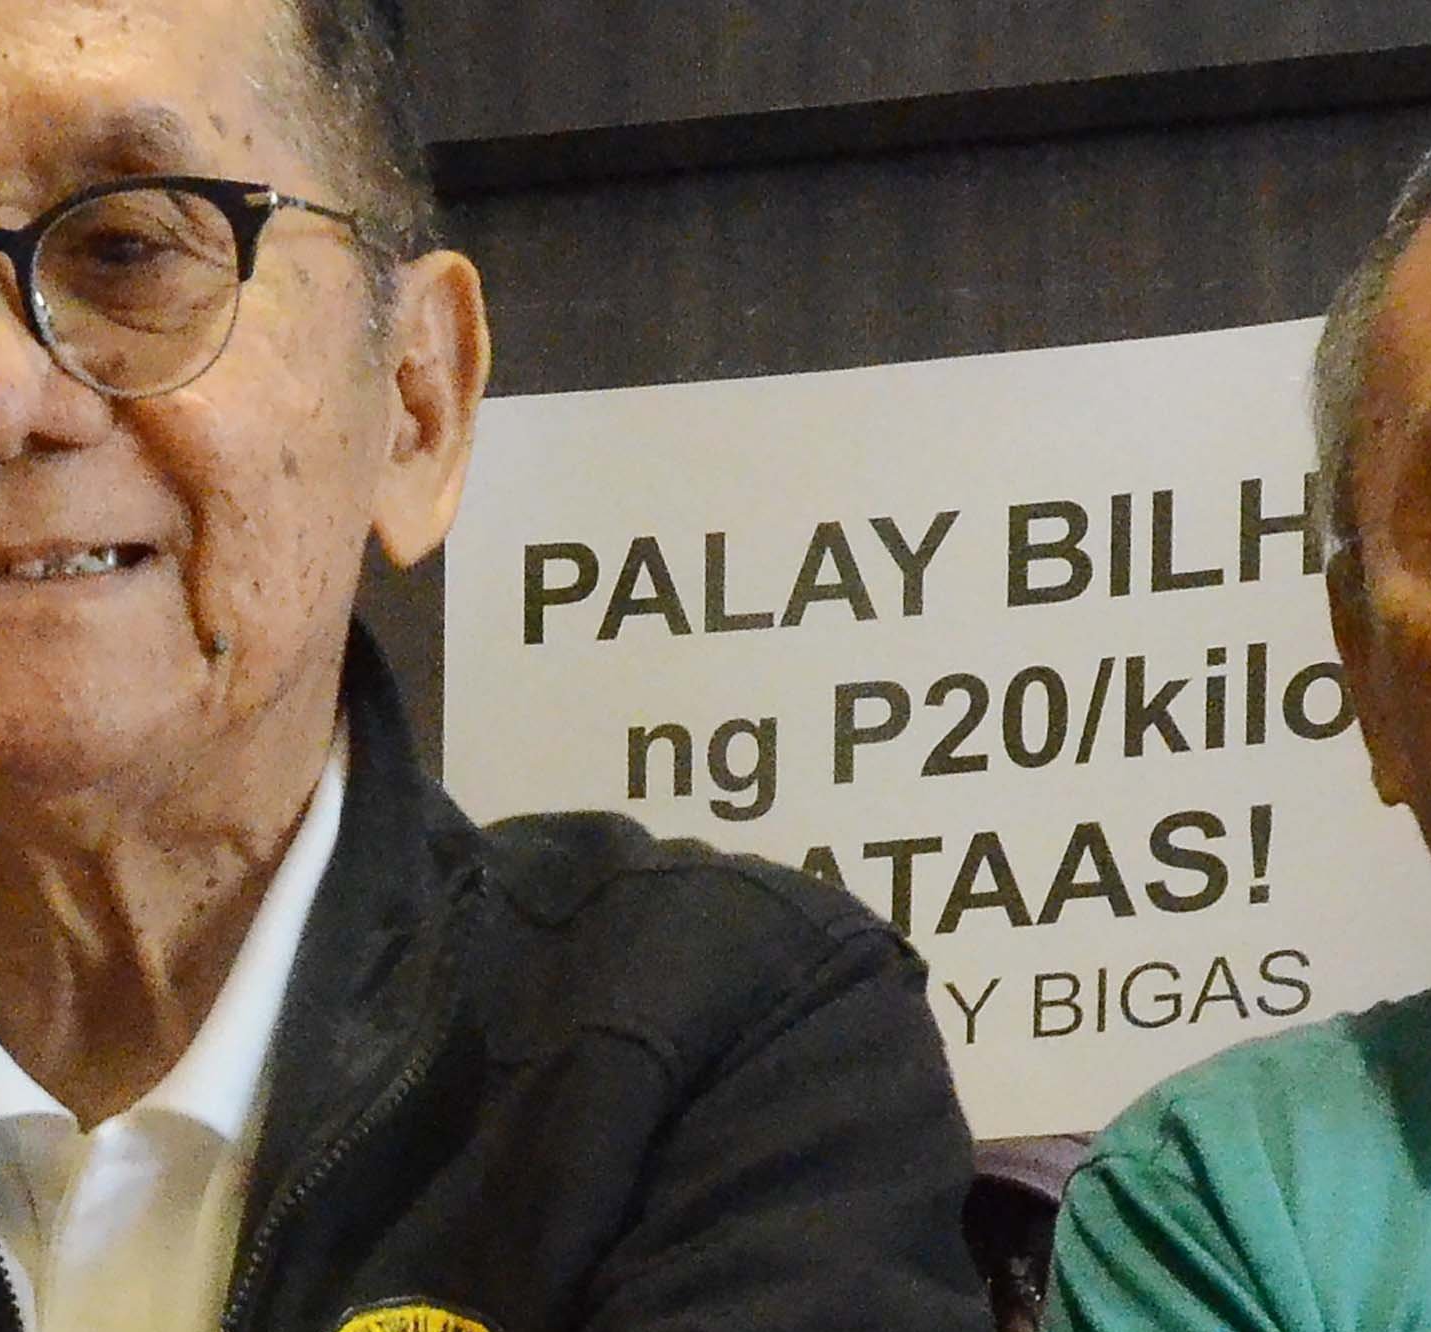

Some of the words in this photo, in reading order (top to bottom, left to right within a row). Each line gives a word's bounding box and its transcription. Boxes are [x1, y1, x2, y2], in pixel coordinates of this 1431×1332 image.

[523, 510, 959, 645] PALAY
[1007, 470, 1325, 608] BILH
[626, 711, 779, 821] ng
[832, 641, 1358, 785] P20/kilo
[944, 977, 1001, 1045] Y
[1031, 949, 1313, 1040] BIGAS
